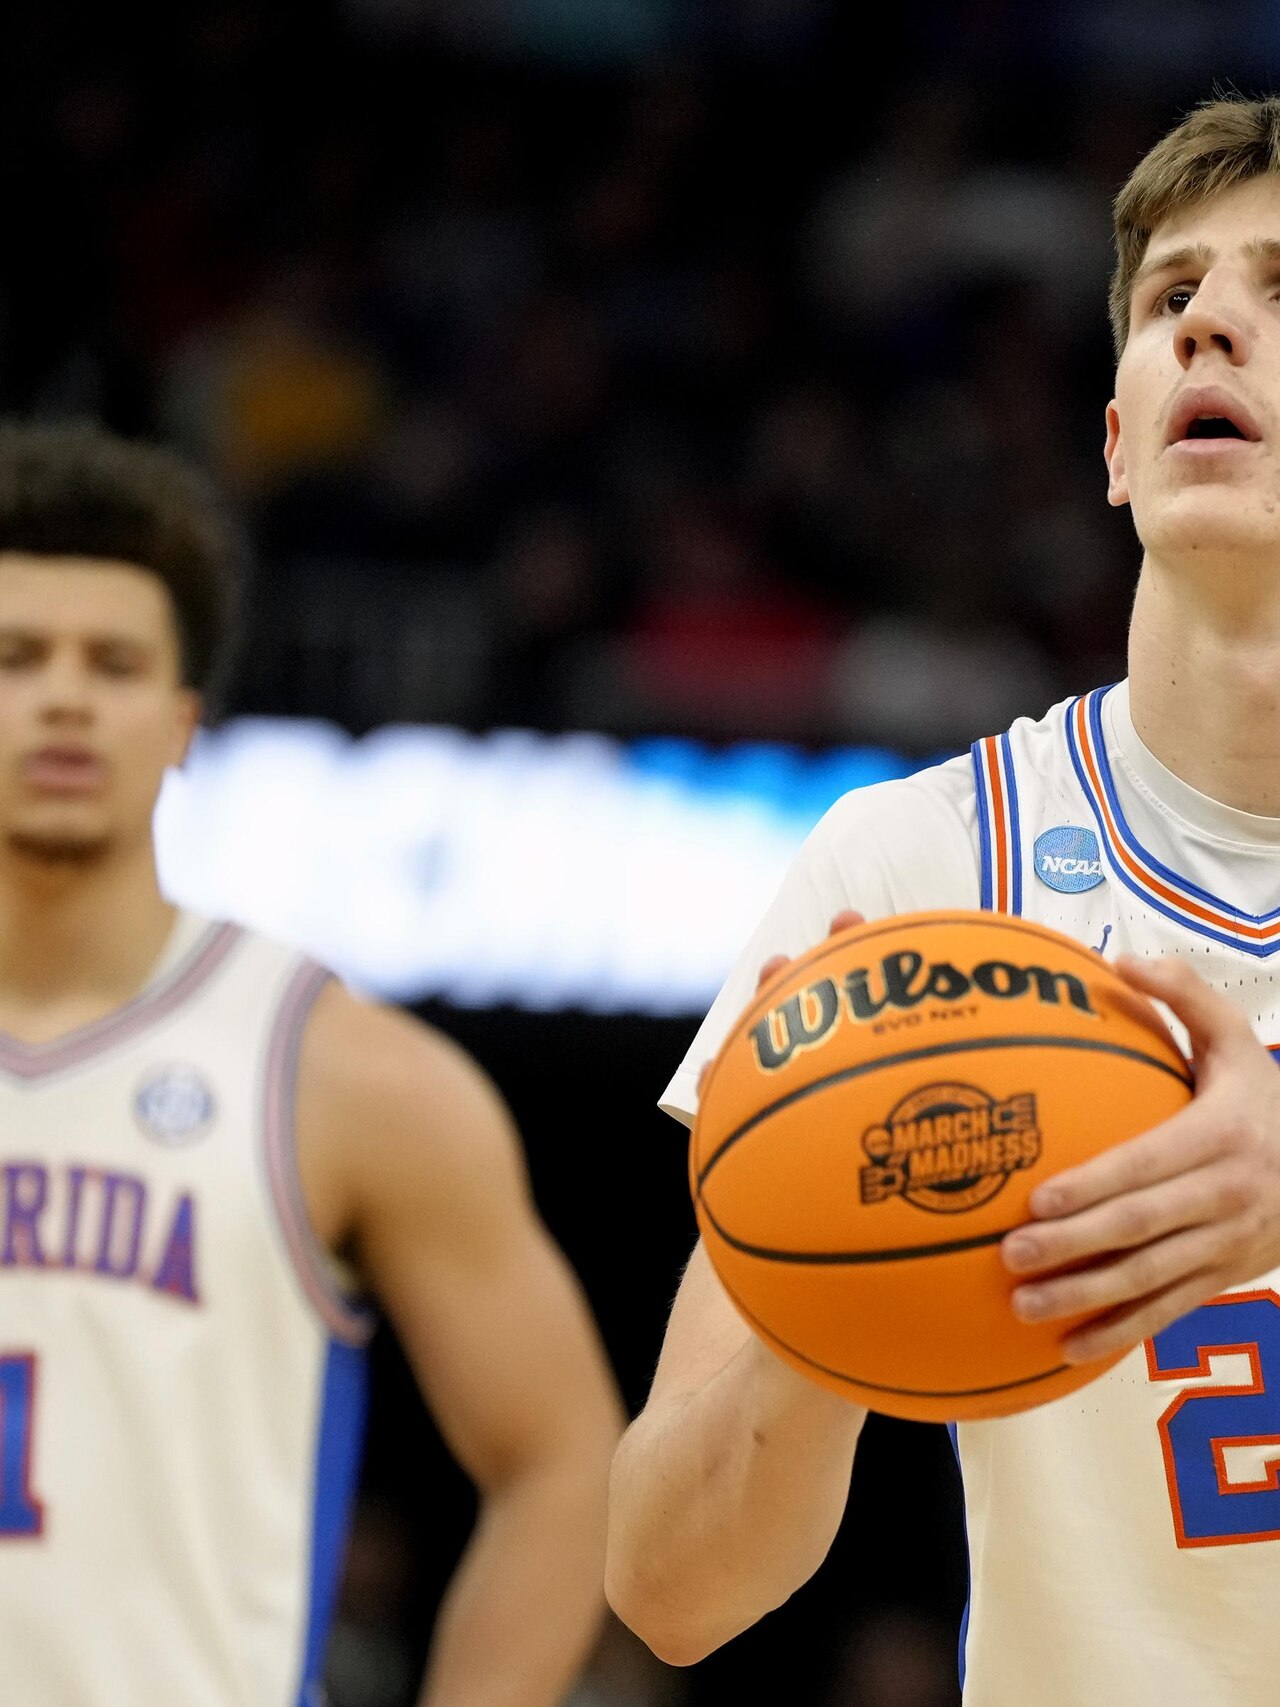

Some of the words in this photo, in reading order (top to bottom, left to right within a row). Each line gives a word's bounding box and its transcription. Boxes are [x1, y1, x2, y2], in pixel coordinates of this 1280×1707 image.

[749, 951, 1098, 1076] Wilson
[893, 1109, 989, 1151] MARCH
[910, 1129, 1038, 1179] MADNESS
